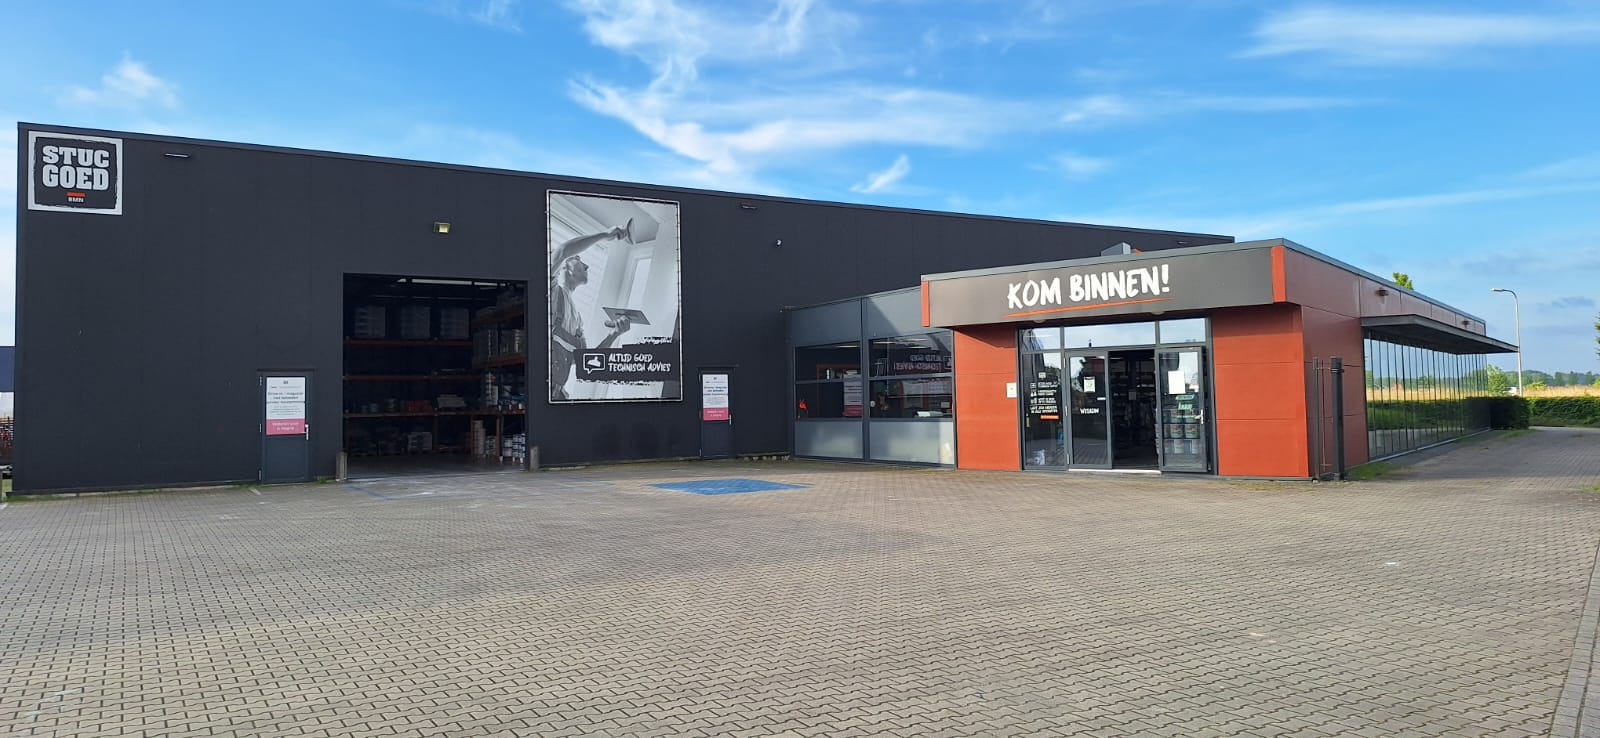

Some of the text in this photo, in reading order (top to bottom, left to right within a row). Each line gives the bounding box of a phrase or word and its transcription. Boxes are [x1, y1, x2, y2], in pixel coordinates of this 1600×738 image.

[42, 145, 109, 168] STUC
[42, 164, 109, 190] GOED
[1007, 264, 1170, 309] KOM BINNEN!
[608, 353, 653, 362] ALTIJD GOED
[608, 361, 671, 372] TECHNISCH ADVIES
